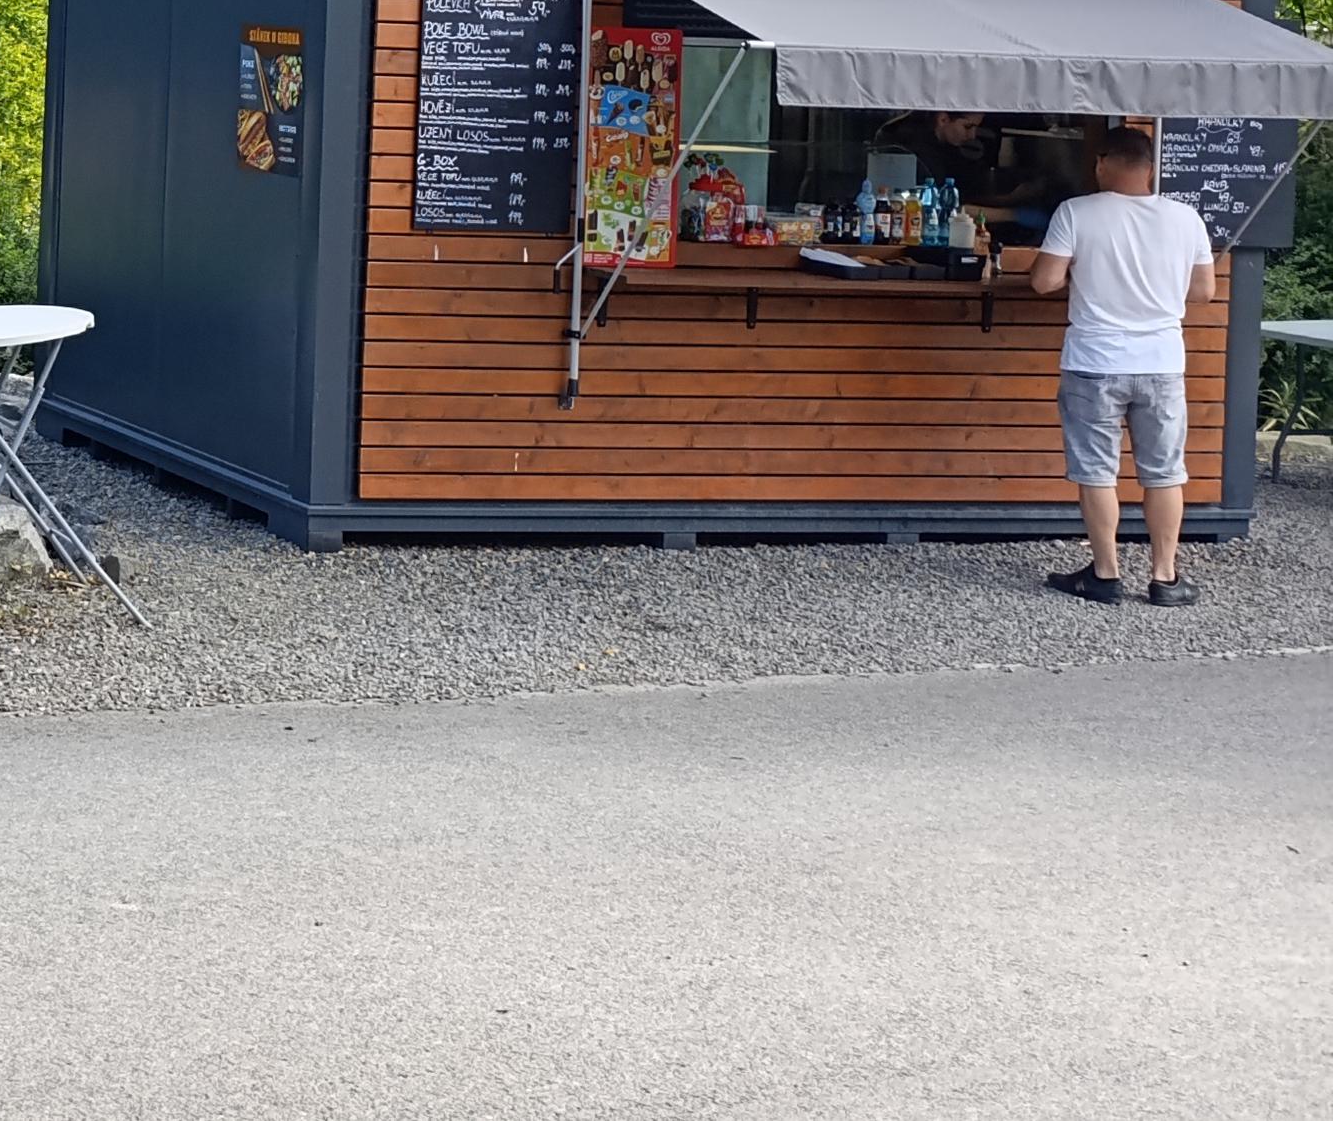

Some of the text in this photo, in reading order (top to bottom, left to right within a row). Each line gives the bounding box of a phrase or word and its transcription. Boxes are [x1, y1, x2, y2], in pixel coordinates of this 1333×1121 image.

[424, 22, 452, 36] POKE
[458, 23, 489, 36] BOWL
[423, 41, 449, 54] VEGE
[452, 42, 480, 54] TOFU
[421, 71, 456, 86] KUŘECÍ
[421, 99, 455, 114] HOVĚZÍ
[457, 130, 489, 142] LOSOS
[441, 172, 462, 182] TOFU
[1203, 177, 1228, 190] KÁVA
[415, 207, 445, 218] LOSOS
[1203, 203, 1229, 212] LUNGO
